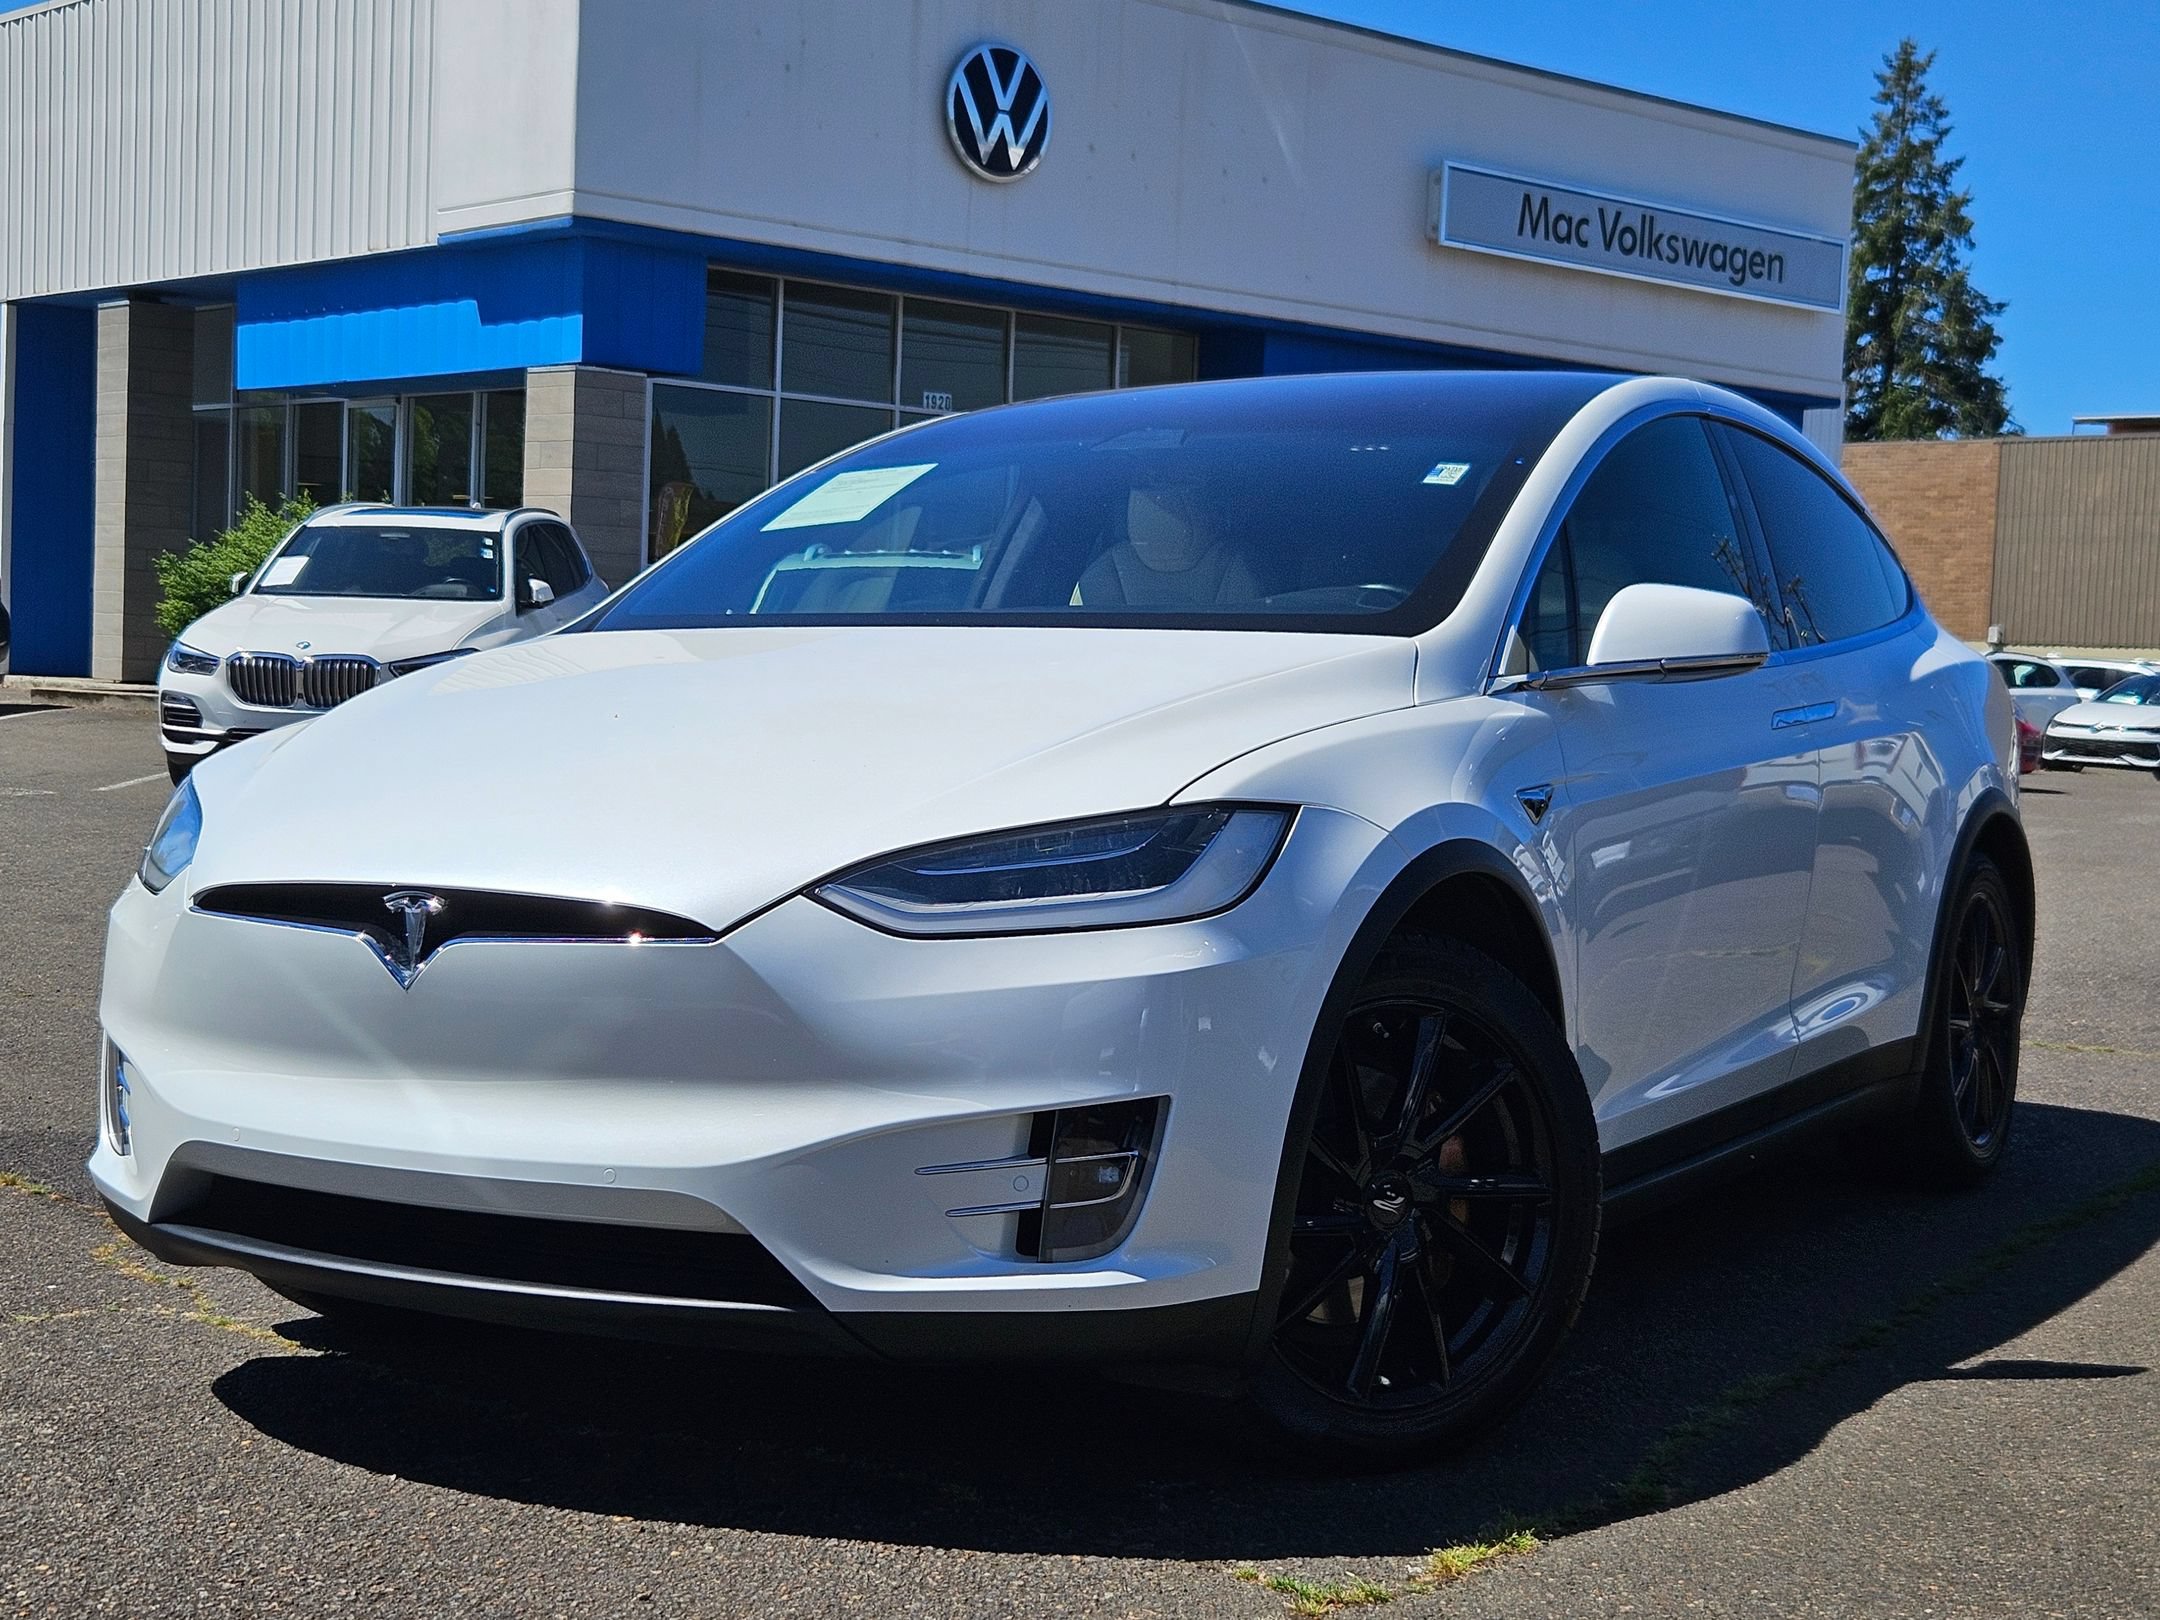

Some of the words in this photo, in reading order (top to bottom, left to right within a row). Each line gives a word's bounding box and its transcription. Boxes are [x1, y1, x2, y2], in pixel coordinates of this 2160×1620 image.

[952, 44, 1049, 171] VW
[1517, 192, 1590, 249] Mac
[1597, 207, 1785, 287] Volkswagen
[925, 394, 951, 410] 1920
